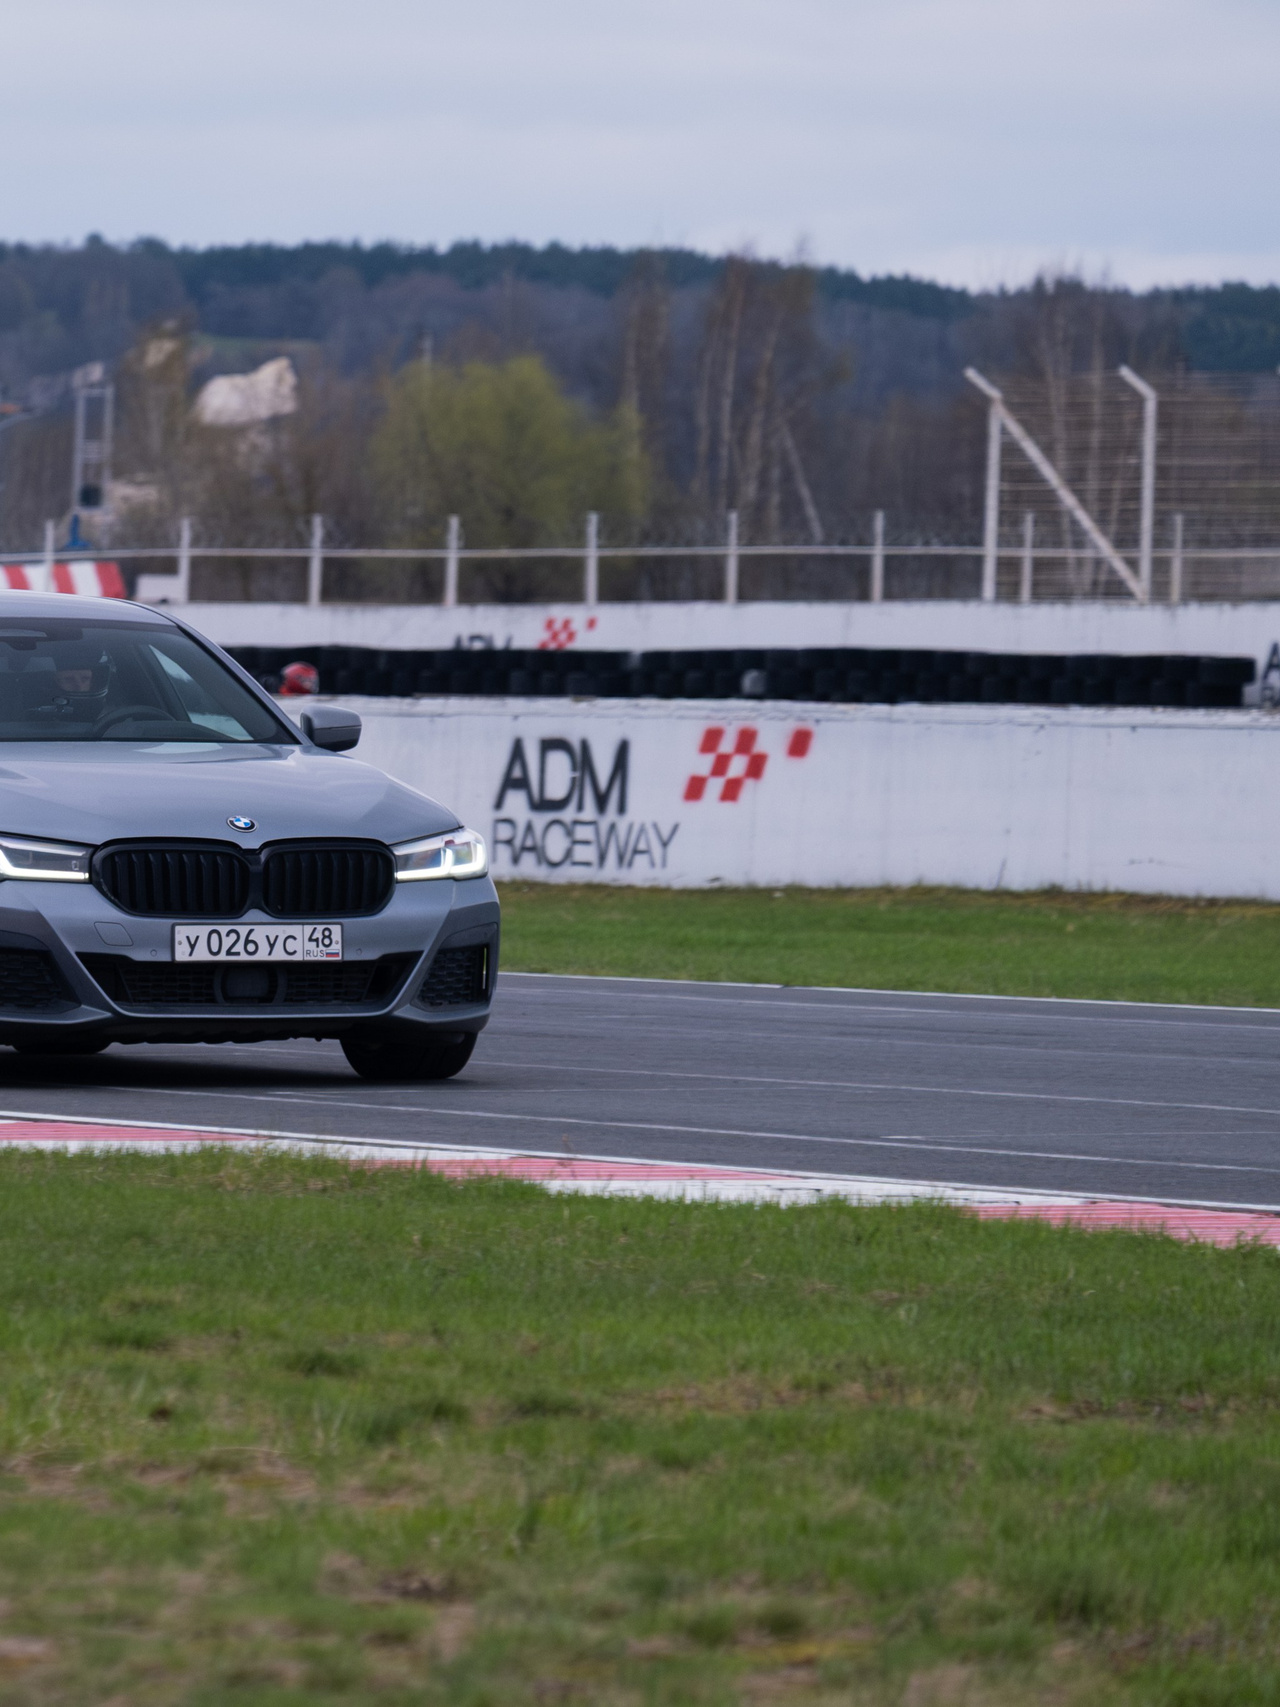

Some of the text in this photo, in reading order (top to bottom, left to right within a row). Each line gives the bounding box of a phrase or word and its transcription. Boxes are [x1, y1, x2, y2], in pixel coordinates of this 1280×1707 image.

[493, 736, 631, 816] ADM
[491, 817, 680, 870] RACEWAY
[305, 949, 325, 958] RUS
[307, 926, 333, 949] 48
